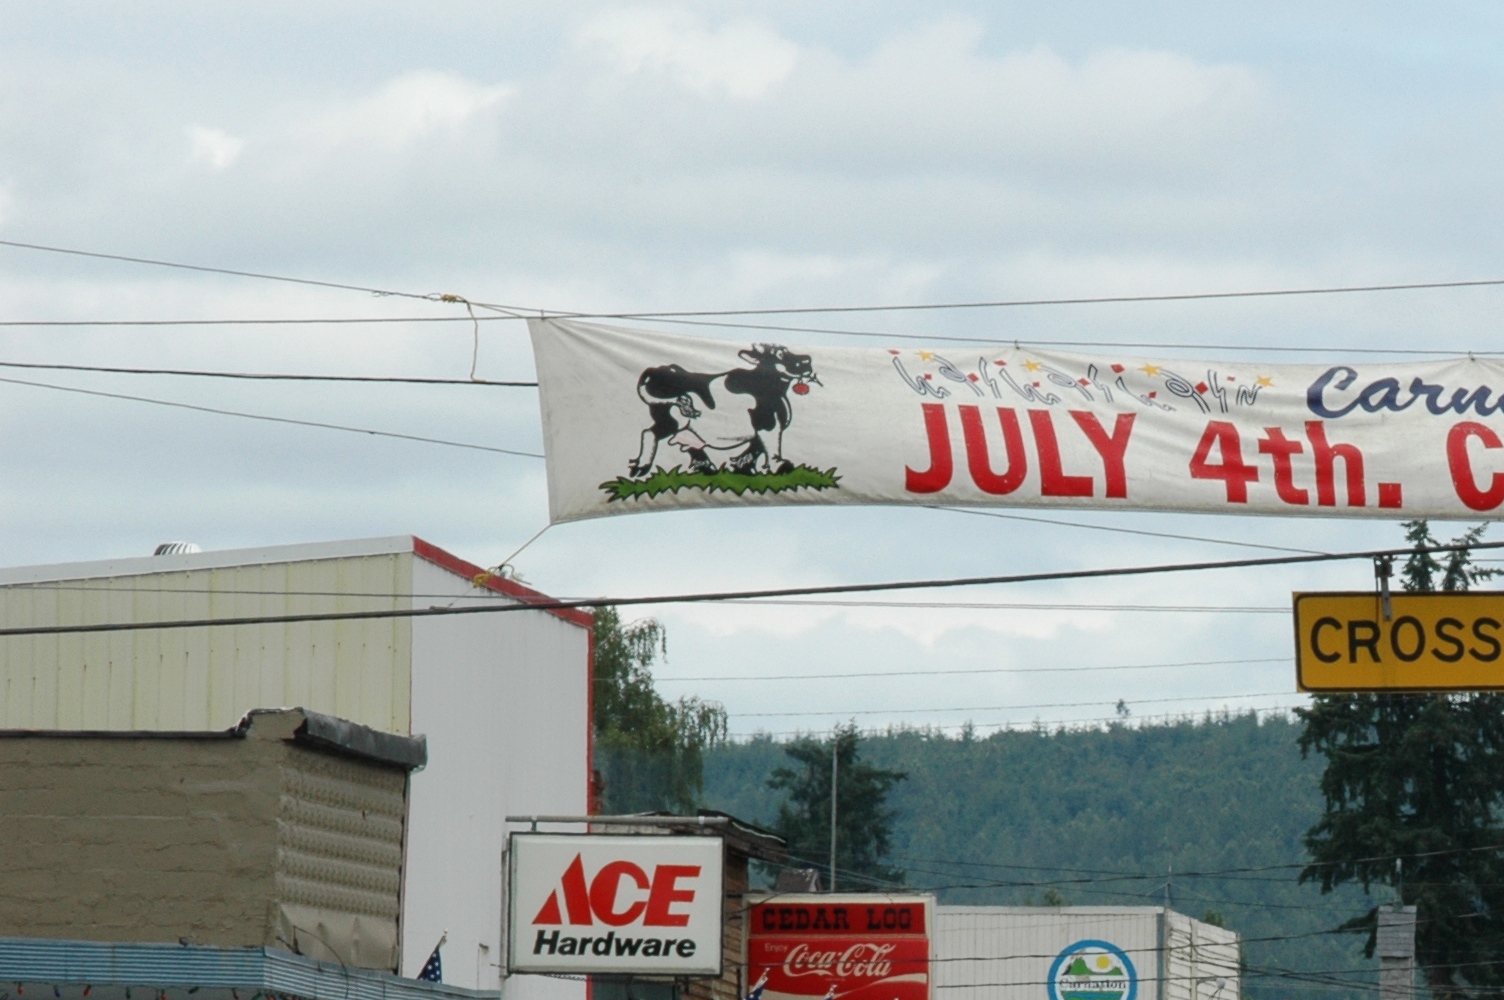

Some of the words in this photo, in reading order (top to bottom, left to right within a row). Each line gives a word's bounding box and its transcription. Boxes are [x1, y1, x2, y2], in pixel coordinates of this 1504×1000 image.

[904, 403, 1136, 499] JULY
[1189, 420, 1403, 509] 4th.
[531, 852, 702, 927] ACE
[533, 930, 697, 958] Hardware
[762, 907, 849, 930] CEDAR
[867, 907, 912, 930] LOG
